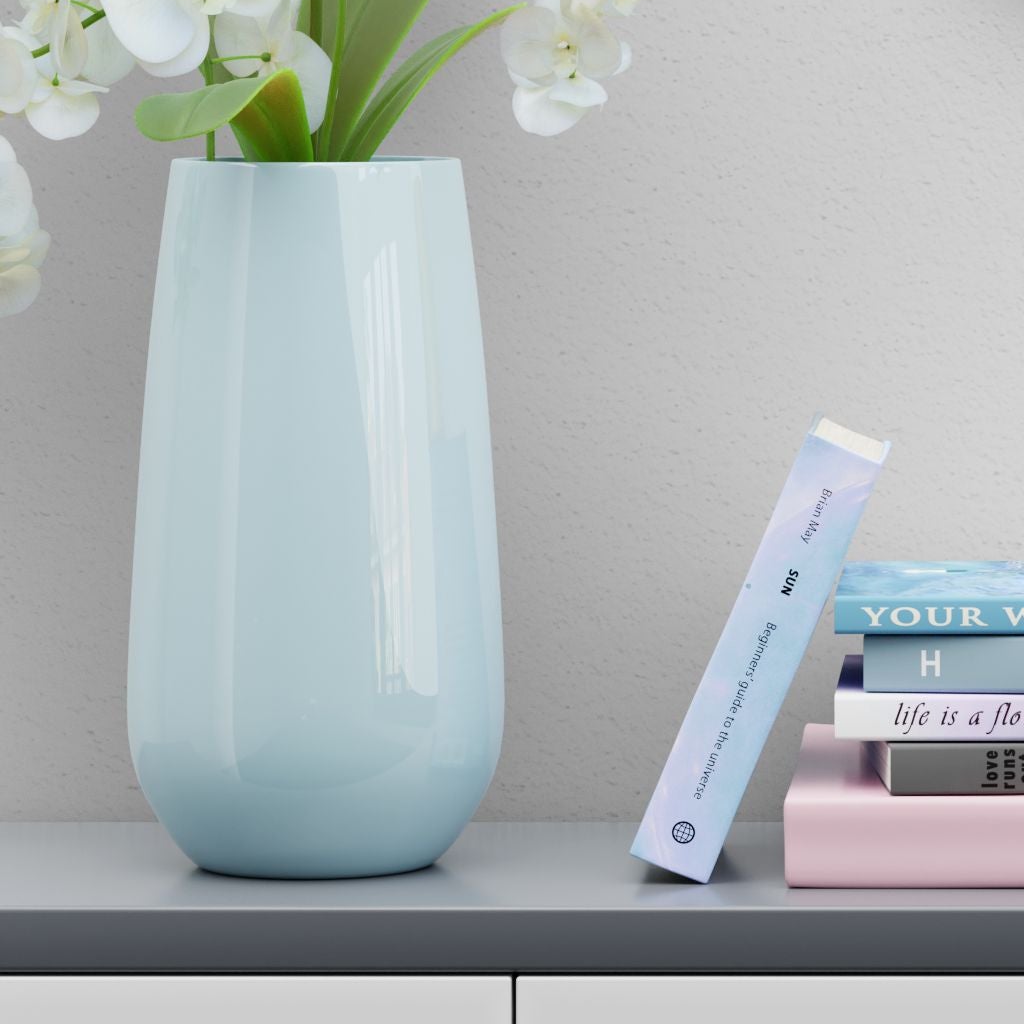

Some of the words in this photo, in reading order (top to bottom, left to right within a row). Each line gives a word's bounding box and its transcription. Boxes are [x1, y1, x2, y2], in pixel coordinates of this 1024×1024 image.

[812, 488, 833, 518] Brian
[800, 519, 820, 545] May
[780, 568, 799, 596] SUN
[861, 606, 988, 627] YOUR
[729, 680, 749, 714] guide
[723, 716, 735, 728] to
[894, 702, 930, 735] life
[940, 706, 959, 726] is
[968, 710, 984, 726] a
[714, 731, 729, 750] the
[693, 753, 719, 800] universe
[981, 750, 999, 788] love
[1003, 748, 1016, 790] runs
